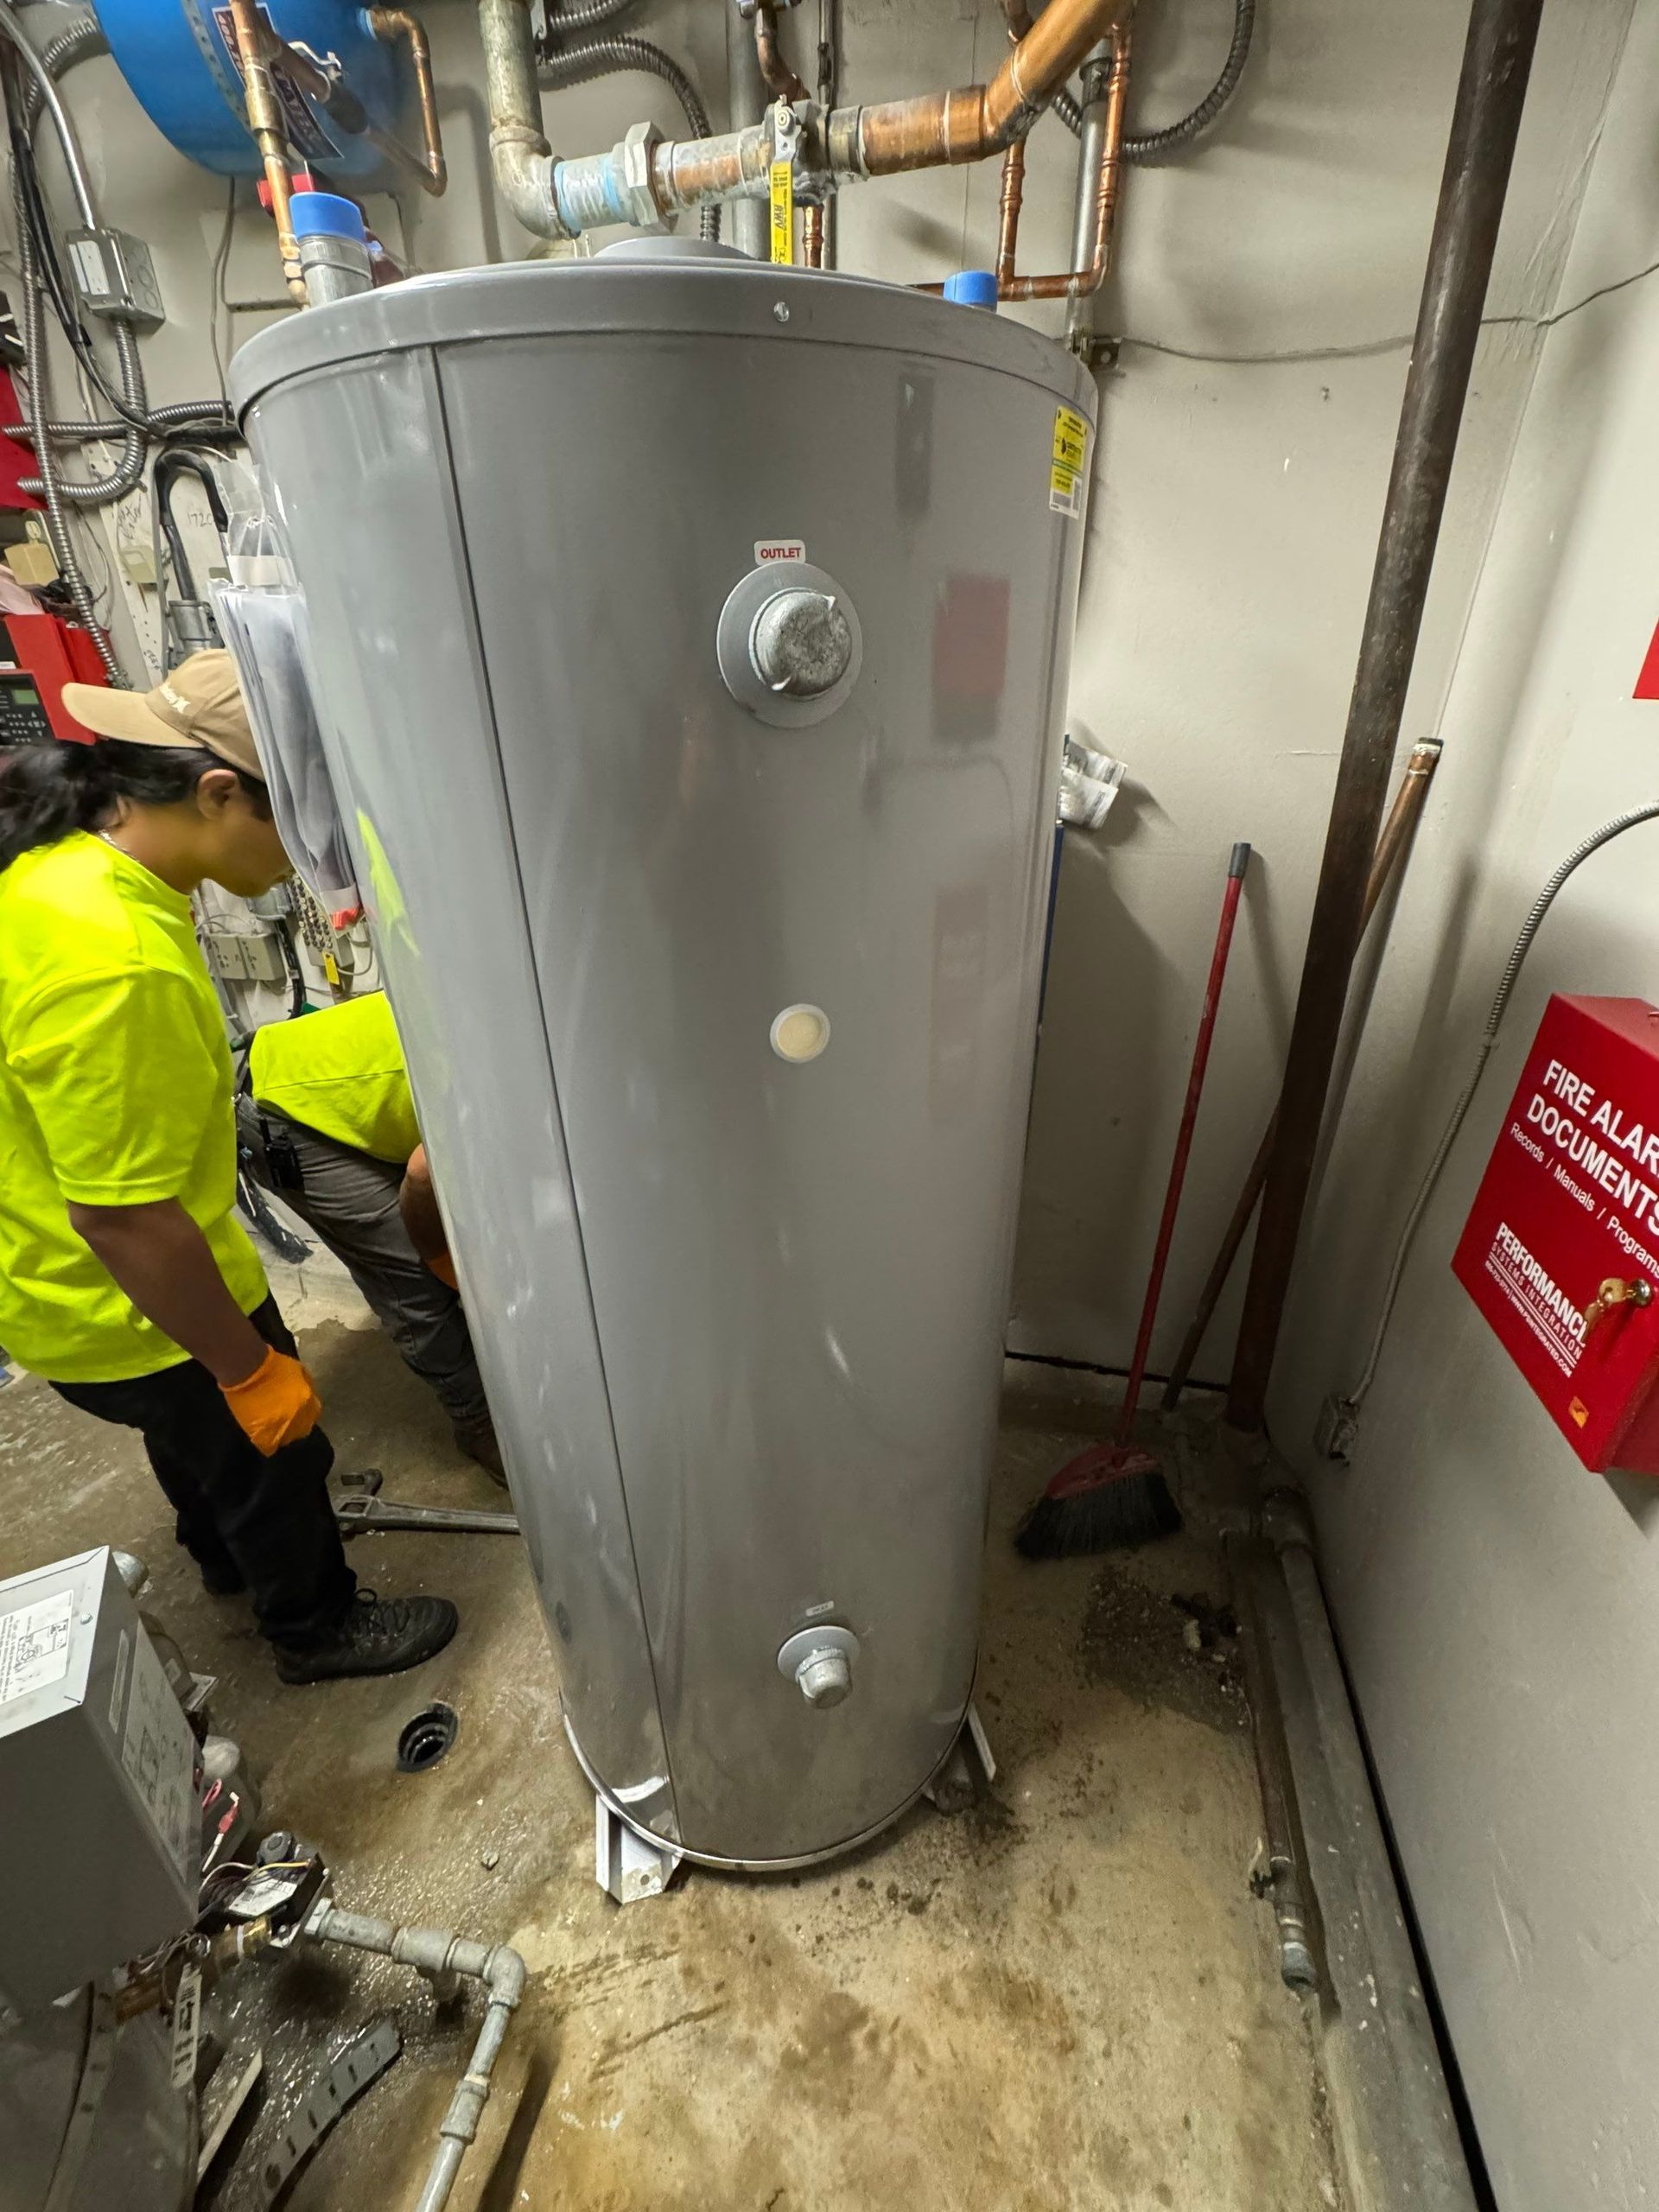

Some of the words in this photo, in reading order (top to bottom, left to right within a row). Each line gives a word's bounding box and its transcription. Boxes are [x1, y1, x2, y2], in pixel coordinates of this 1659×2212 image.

[760, 547, 801, 559] OUTLET
[1510, 1122, 1545, 1162] Records
[1554, 1164, 1595, 1211] Manuals
[1543, 1058, 1595, 1117] FIRE
[1590, 1100, 1659, 1179] ALAR
[1491, 1242, 1526, 1286] SYSTEMS
[1524, 1284, 1583, 1360] INTEGRATION
